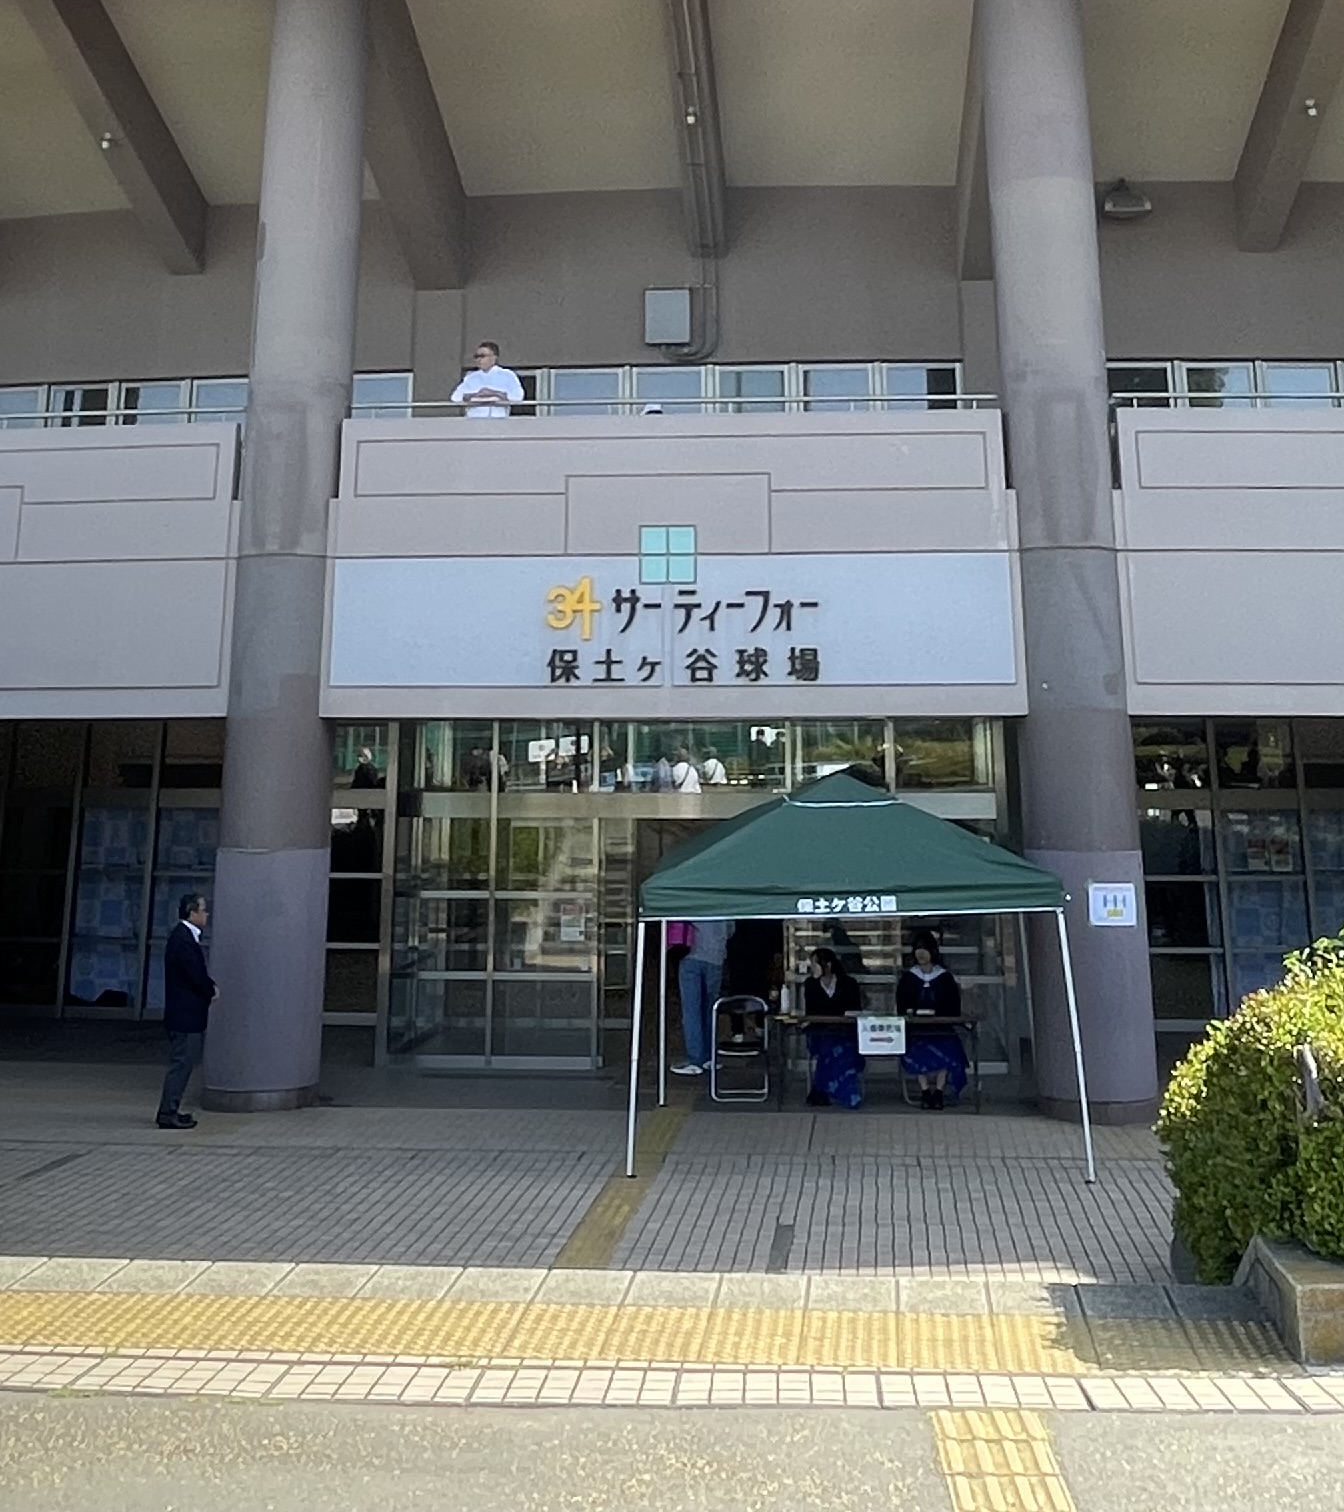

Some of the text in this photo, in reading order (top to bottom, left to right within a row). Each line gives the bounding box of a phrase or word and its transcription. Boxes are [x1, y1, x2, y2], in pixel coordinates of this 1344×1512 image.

[546, 576, 820, 642] 34 サーティーフォー
